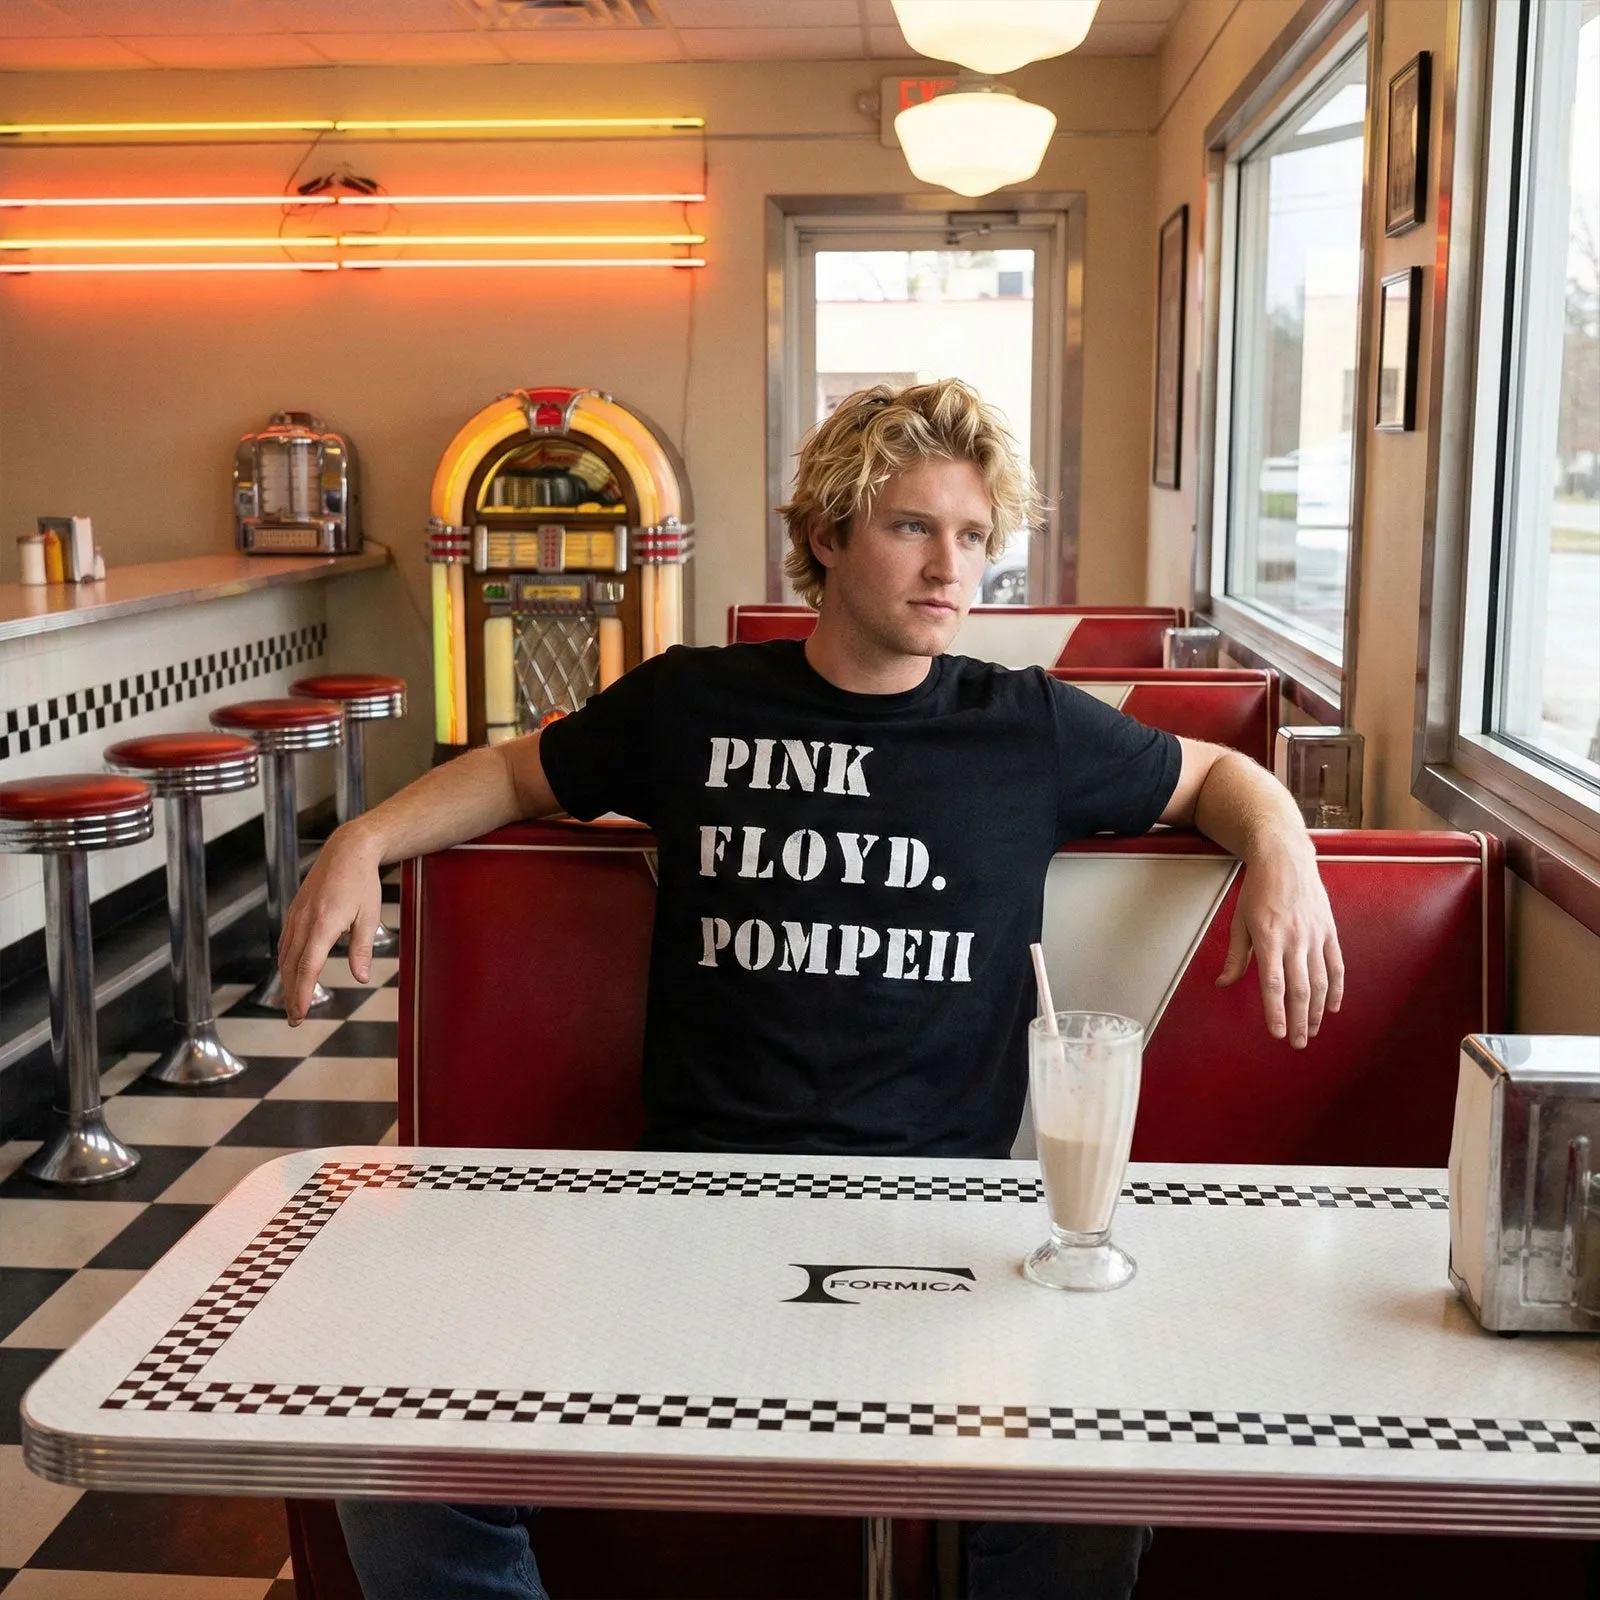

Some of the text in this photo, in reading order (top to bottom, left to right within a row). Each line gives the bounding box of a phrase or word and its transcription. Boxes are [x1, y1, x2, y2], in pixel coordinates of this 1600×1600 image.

[705, 737, 873, 797] PINK
[699, 825, 946, 890] FLOYD.
[698, 917, 974, 982] POMPEII
[829, 1280, 971, 1292] FORMICA
